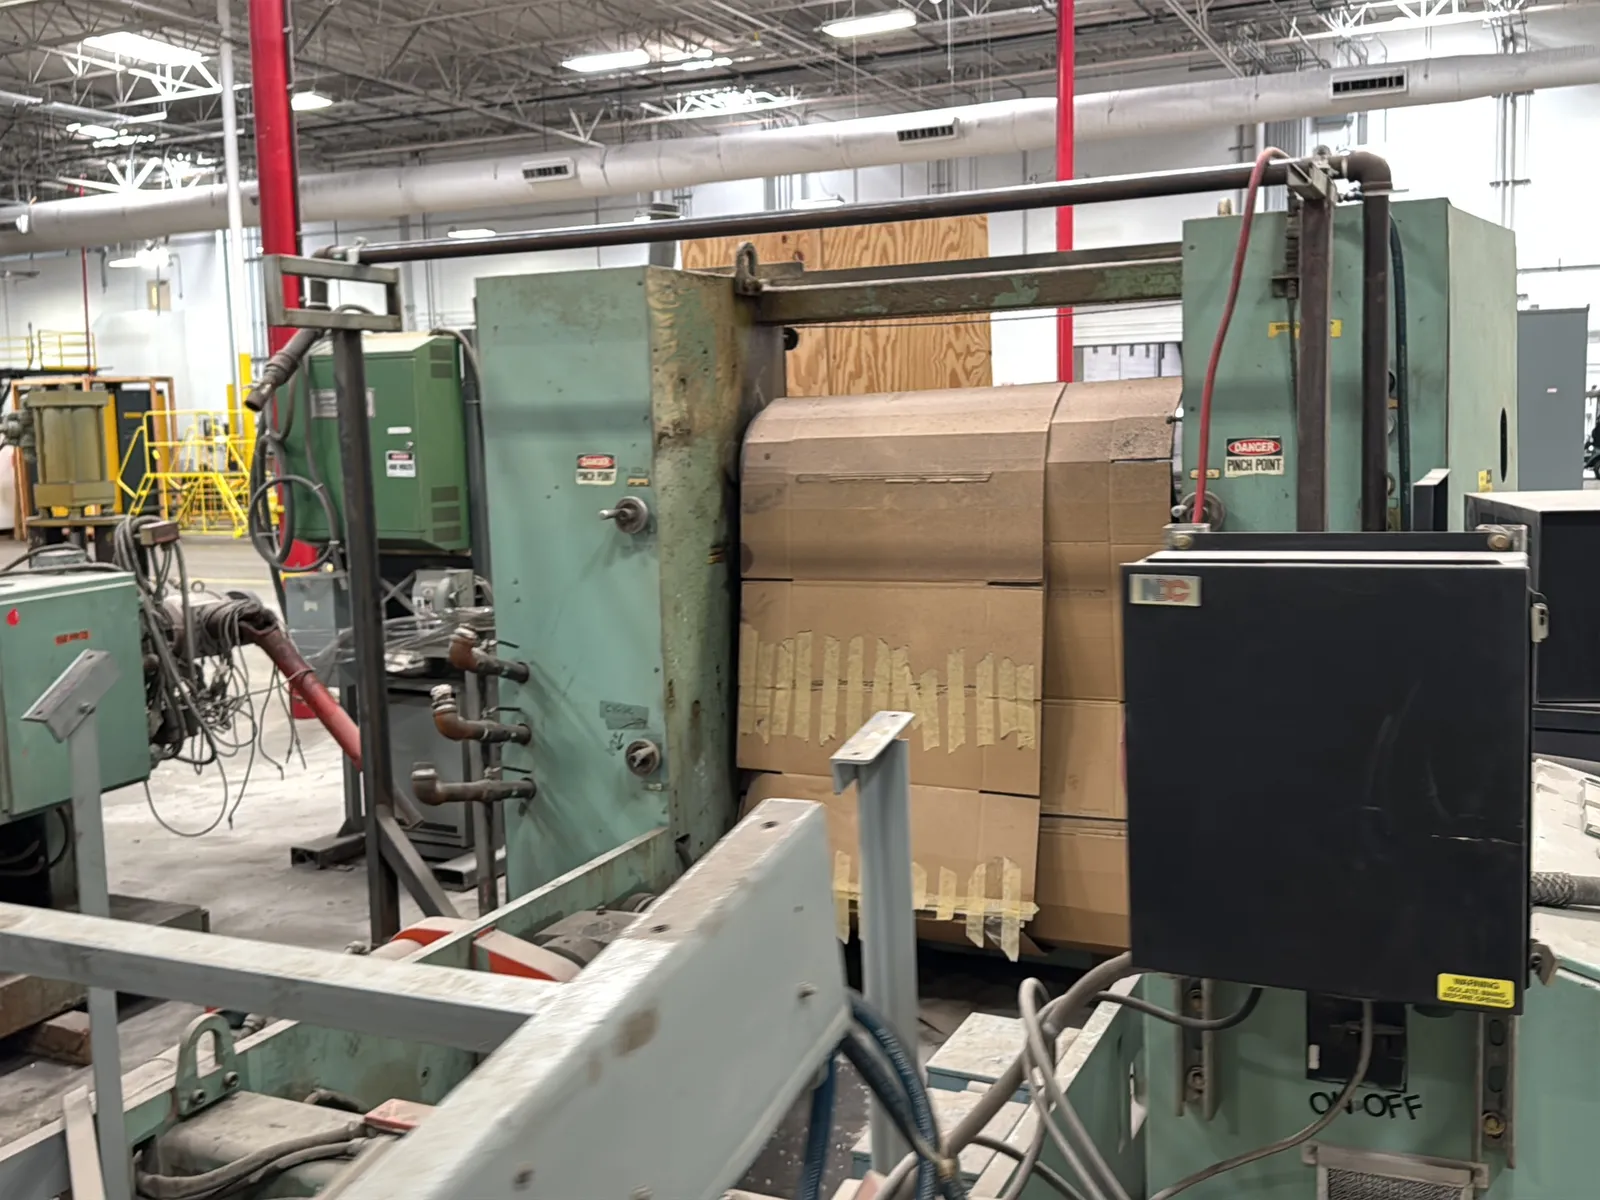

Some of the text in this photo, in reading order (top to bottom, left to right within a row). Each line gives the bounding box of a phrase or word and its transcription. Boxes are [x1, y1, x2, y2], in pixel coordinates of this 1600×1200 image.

[1234, 441, 1275, 453] DANGER
[1227, 458, 1282, 471] PINCH POINT
[1363, 1093, 1423, 1120] OFF
